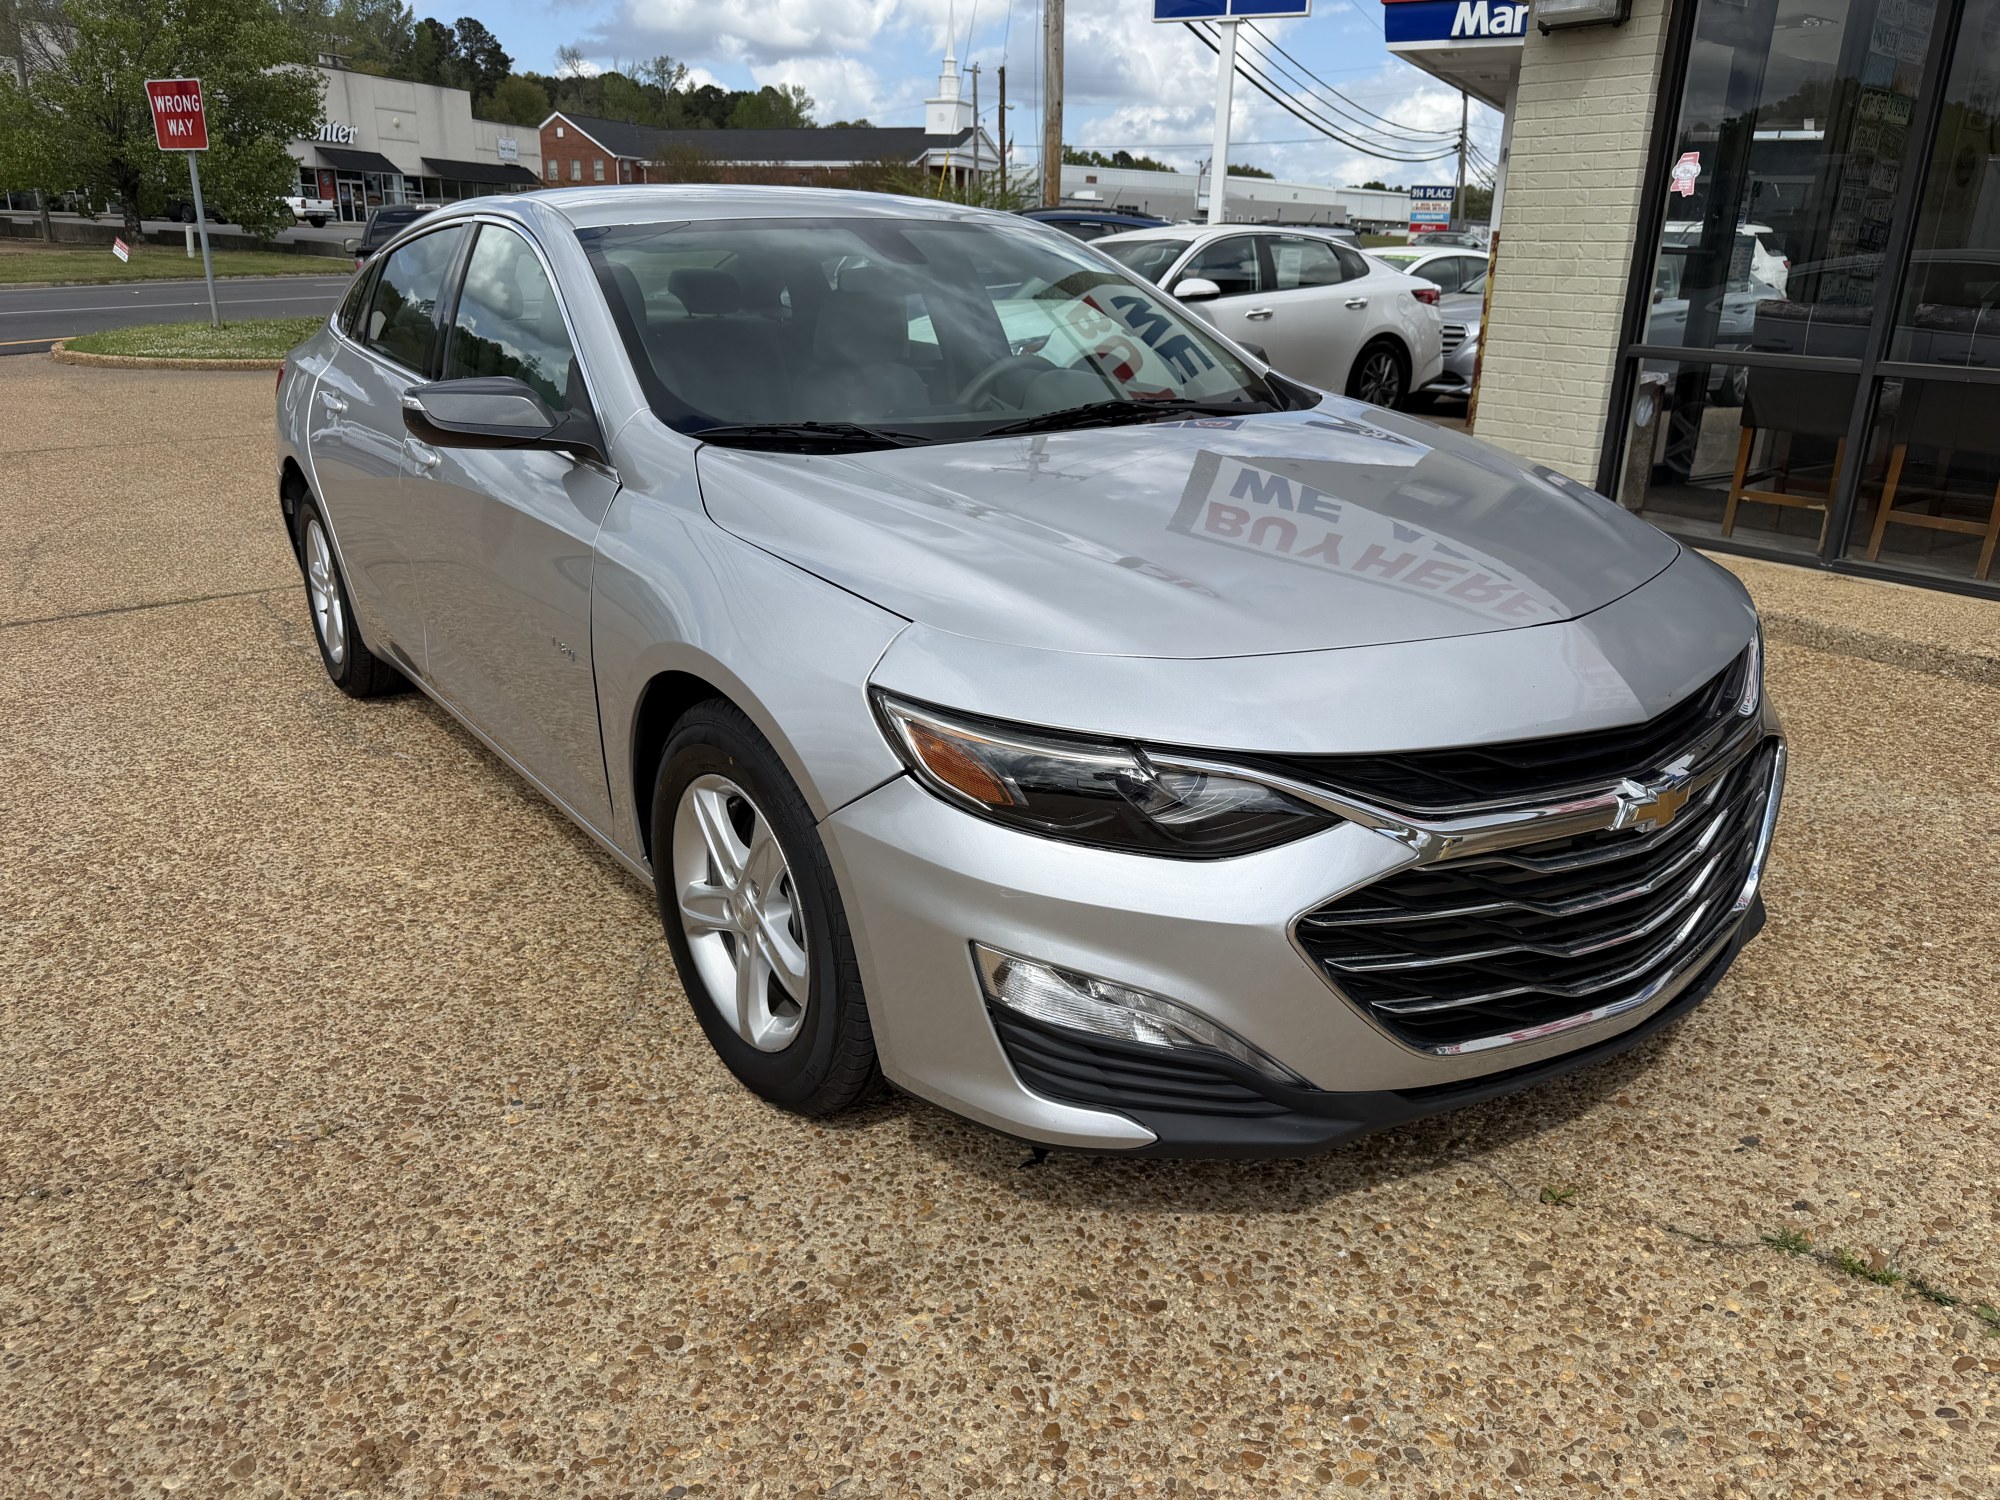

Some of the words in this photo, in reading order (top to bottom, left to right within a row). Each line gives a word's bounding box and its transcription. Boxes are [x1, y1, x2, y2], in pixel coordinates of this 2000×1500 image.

[154, 95, 200, 113] WRONG
[167, 119, 193, 136] WAY
[1426, 188, 1453, 199] PLACE
